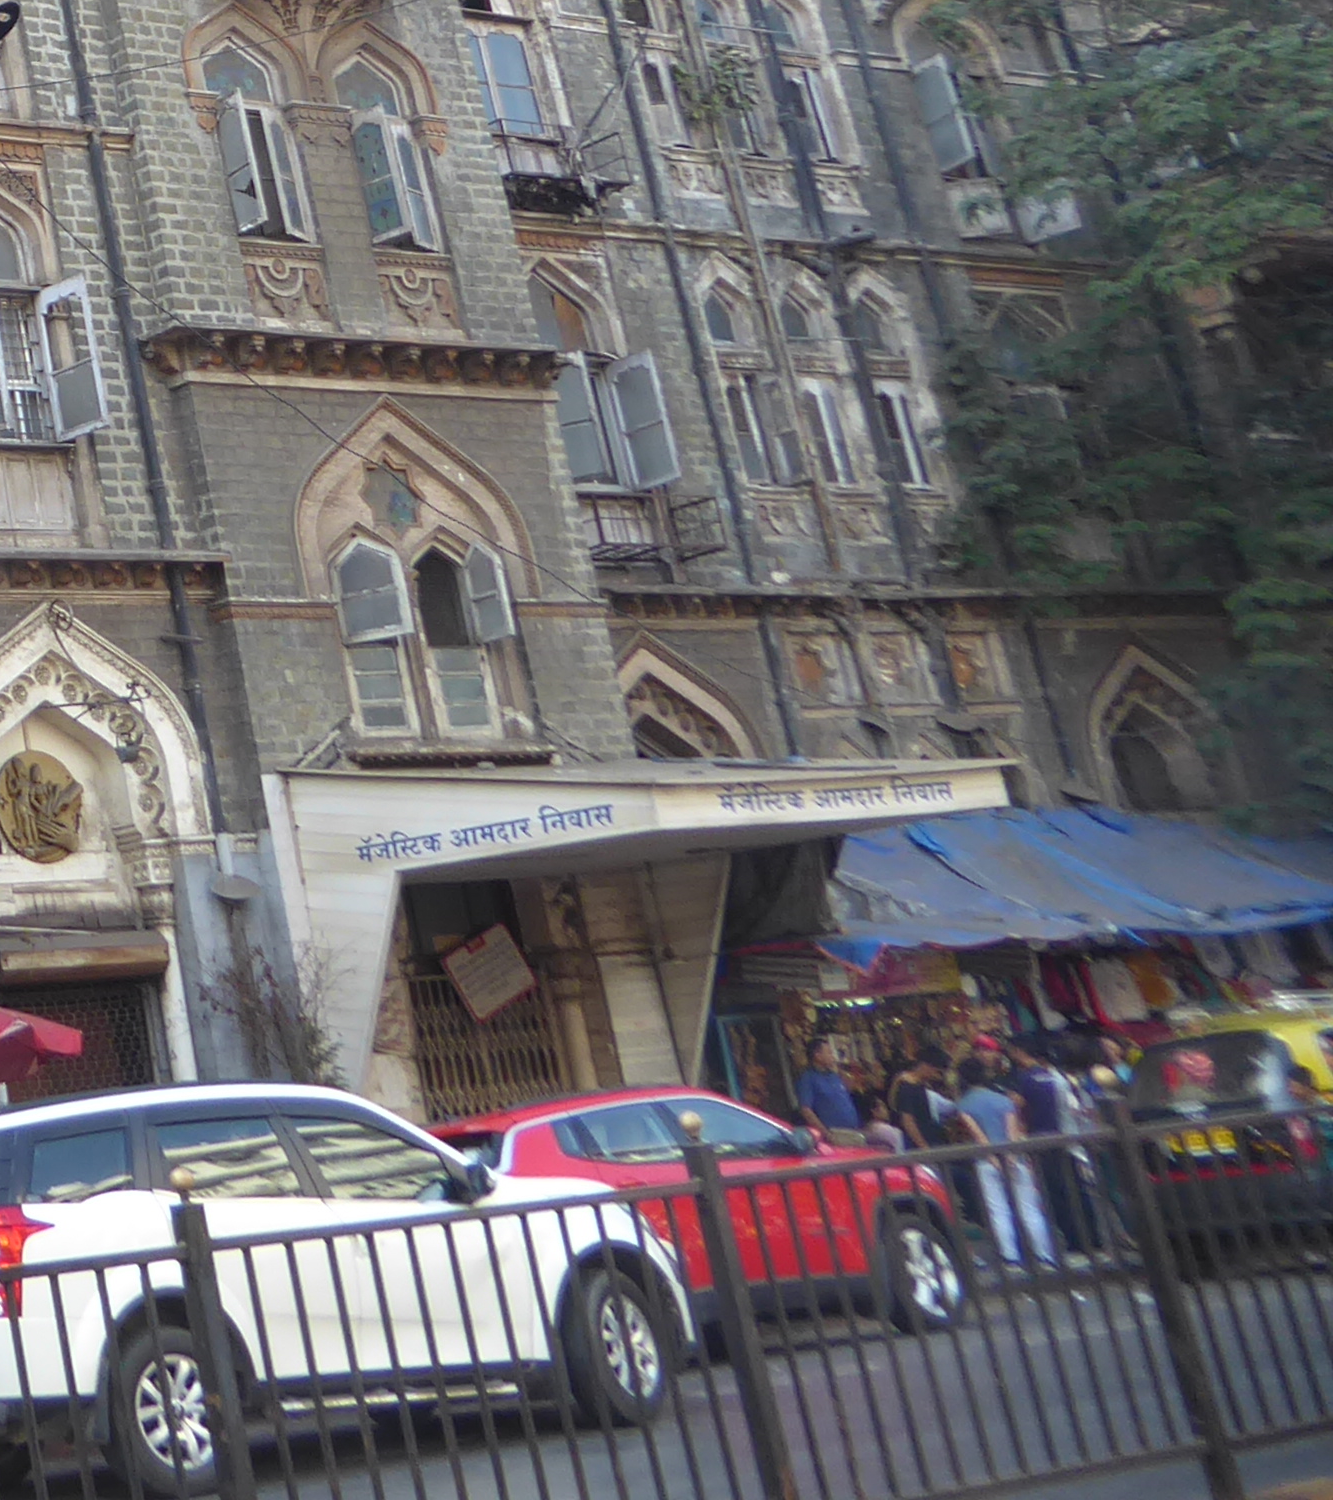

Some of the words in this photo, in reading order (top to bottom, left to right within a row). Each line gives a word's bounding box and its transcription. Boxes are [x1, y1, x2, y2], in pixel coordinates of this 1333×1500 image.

[814, 785, 888, 810] आमदार
[890, 775, 955, 804] निवास
[450, 817, 533, 848] आमदार
[539, 804, 613, 835] निवास
